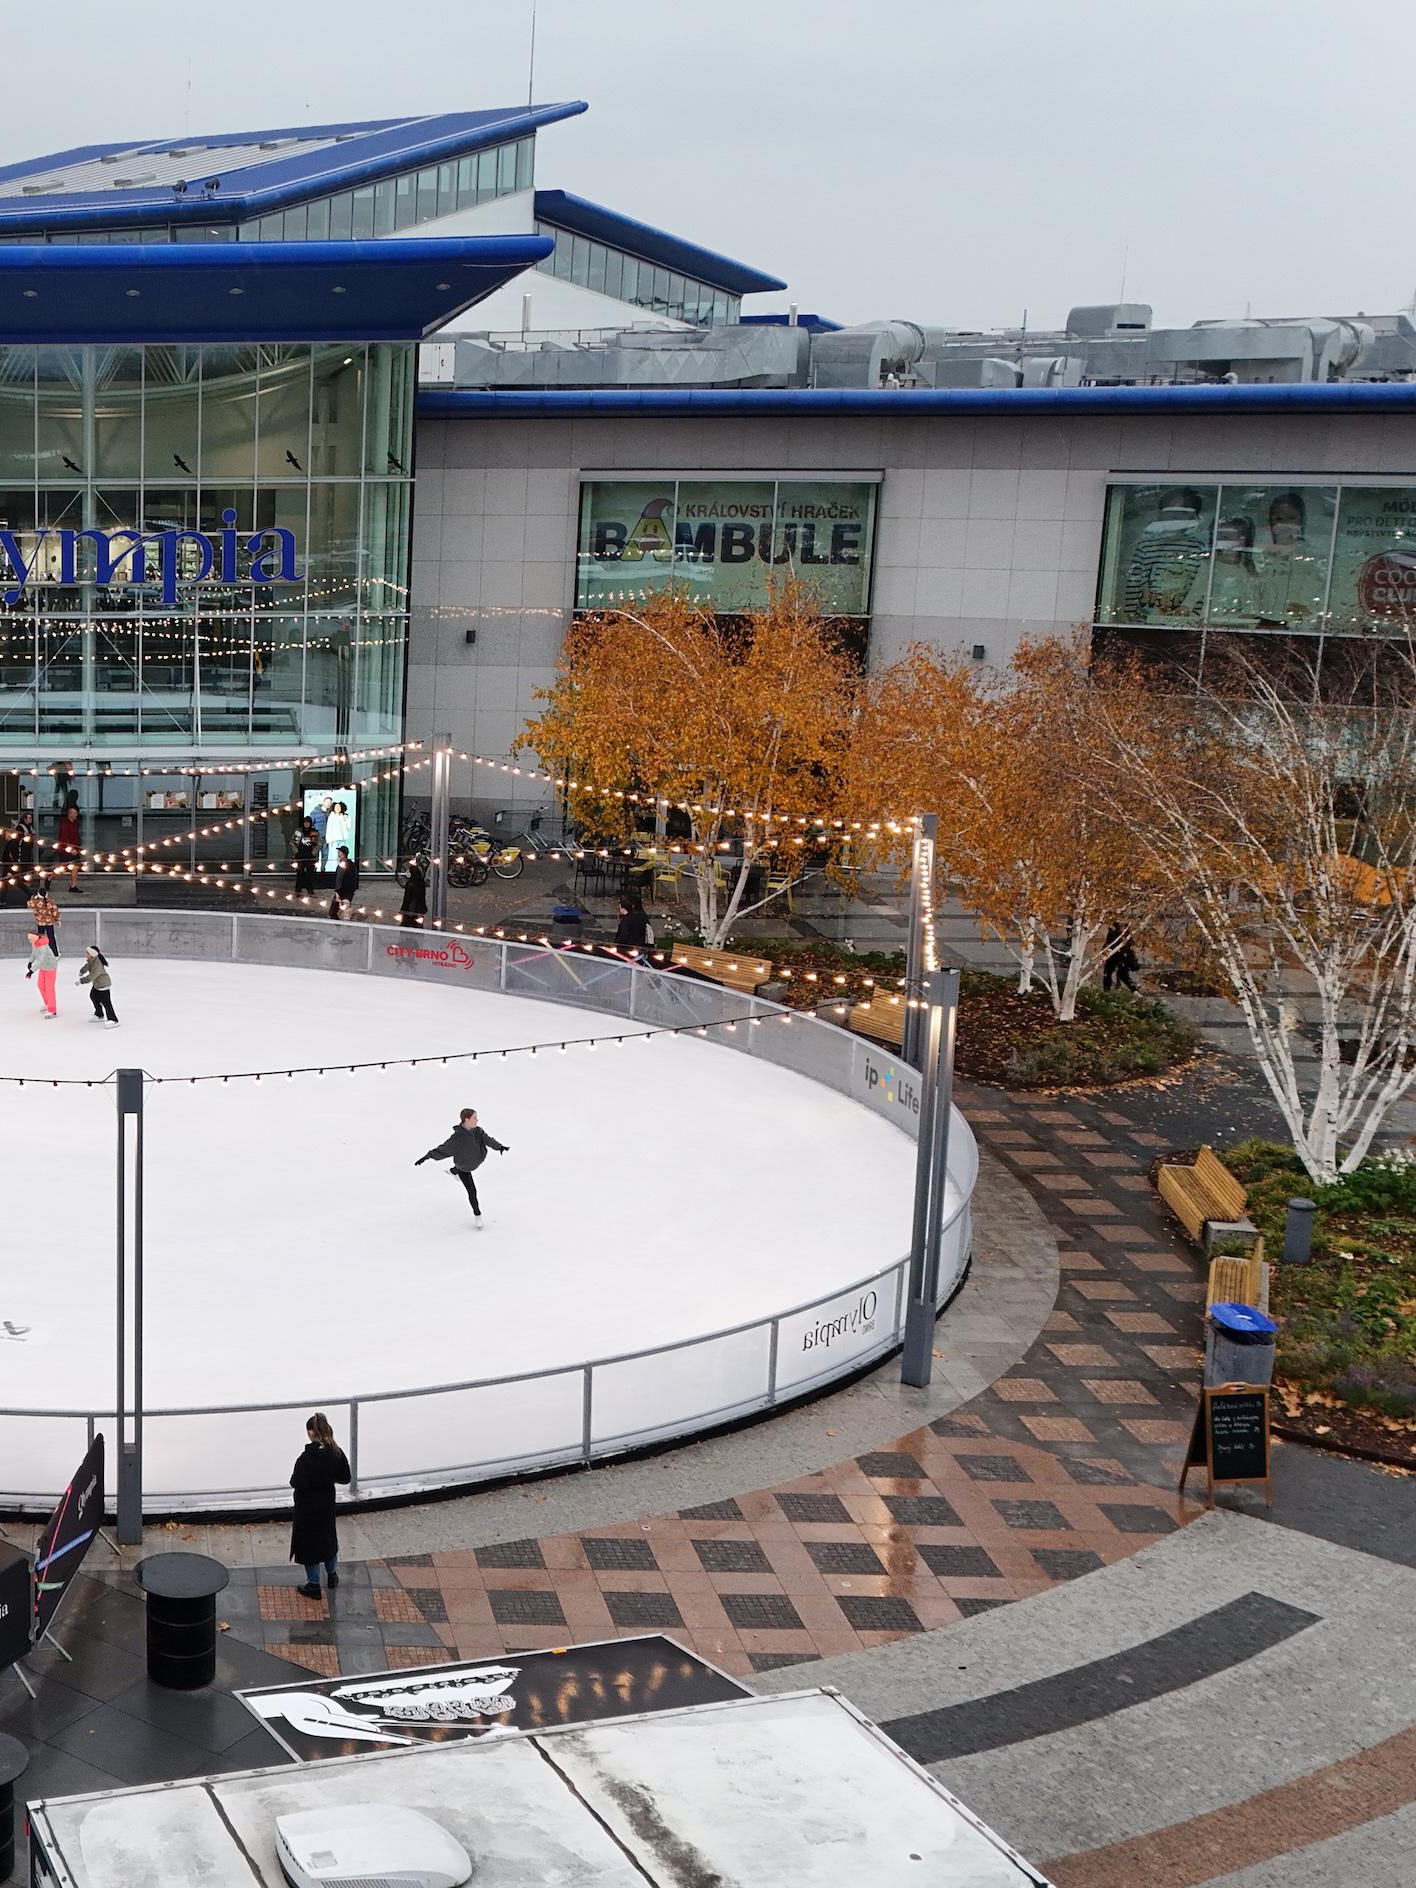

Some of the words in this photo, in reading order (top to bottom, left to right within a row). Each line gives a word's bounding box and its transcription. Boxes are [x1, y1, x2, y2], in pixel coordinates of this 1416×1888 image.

[685, 500, 787, 519] KRÁLOVSTVÍ
[791, 502, 860, 520] HRAČEK
[595, 521, 862, 564] BAMBULE
[1372, 587, 1416, 601] CLU
[898, 1080, 919, 1114] Life
